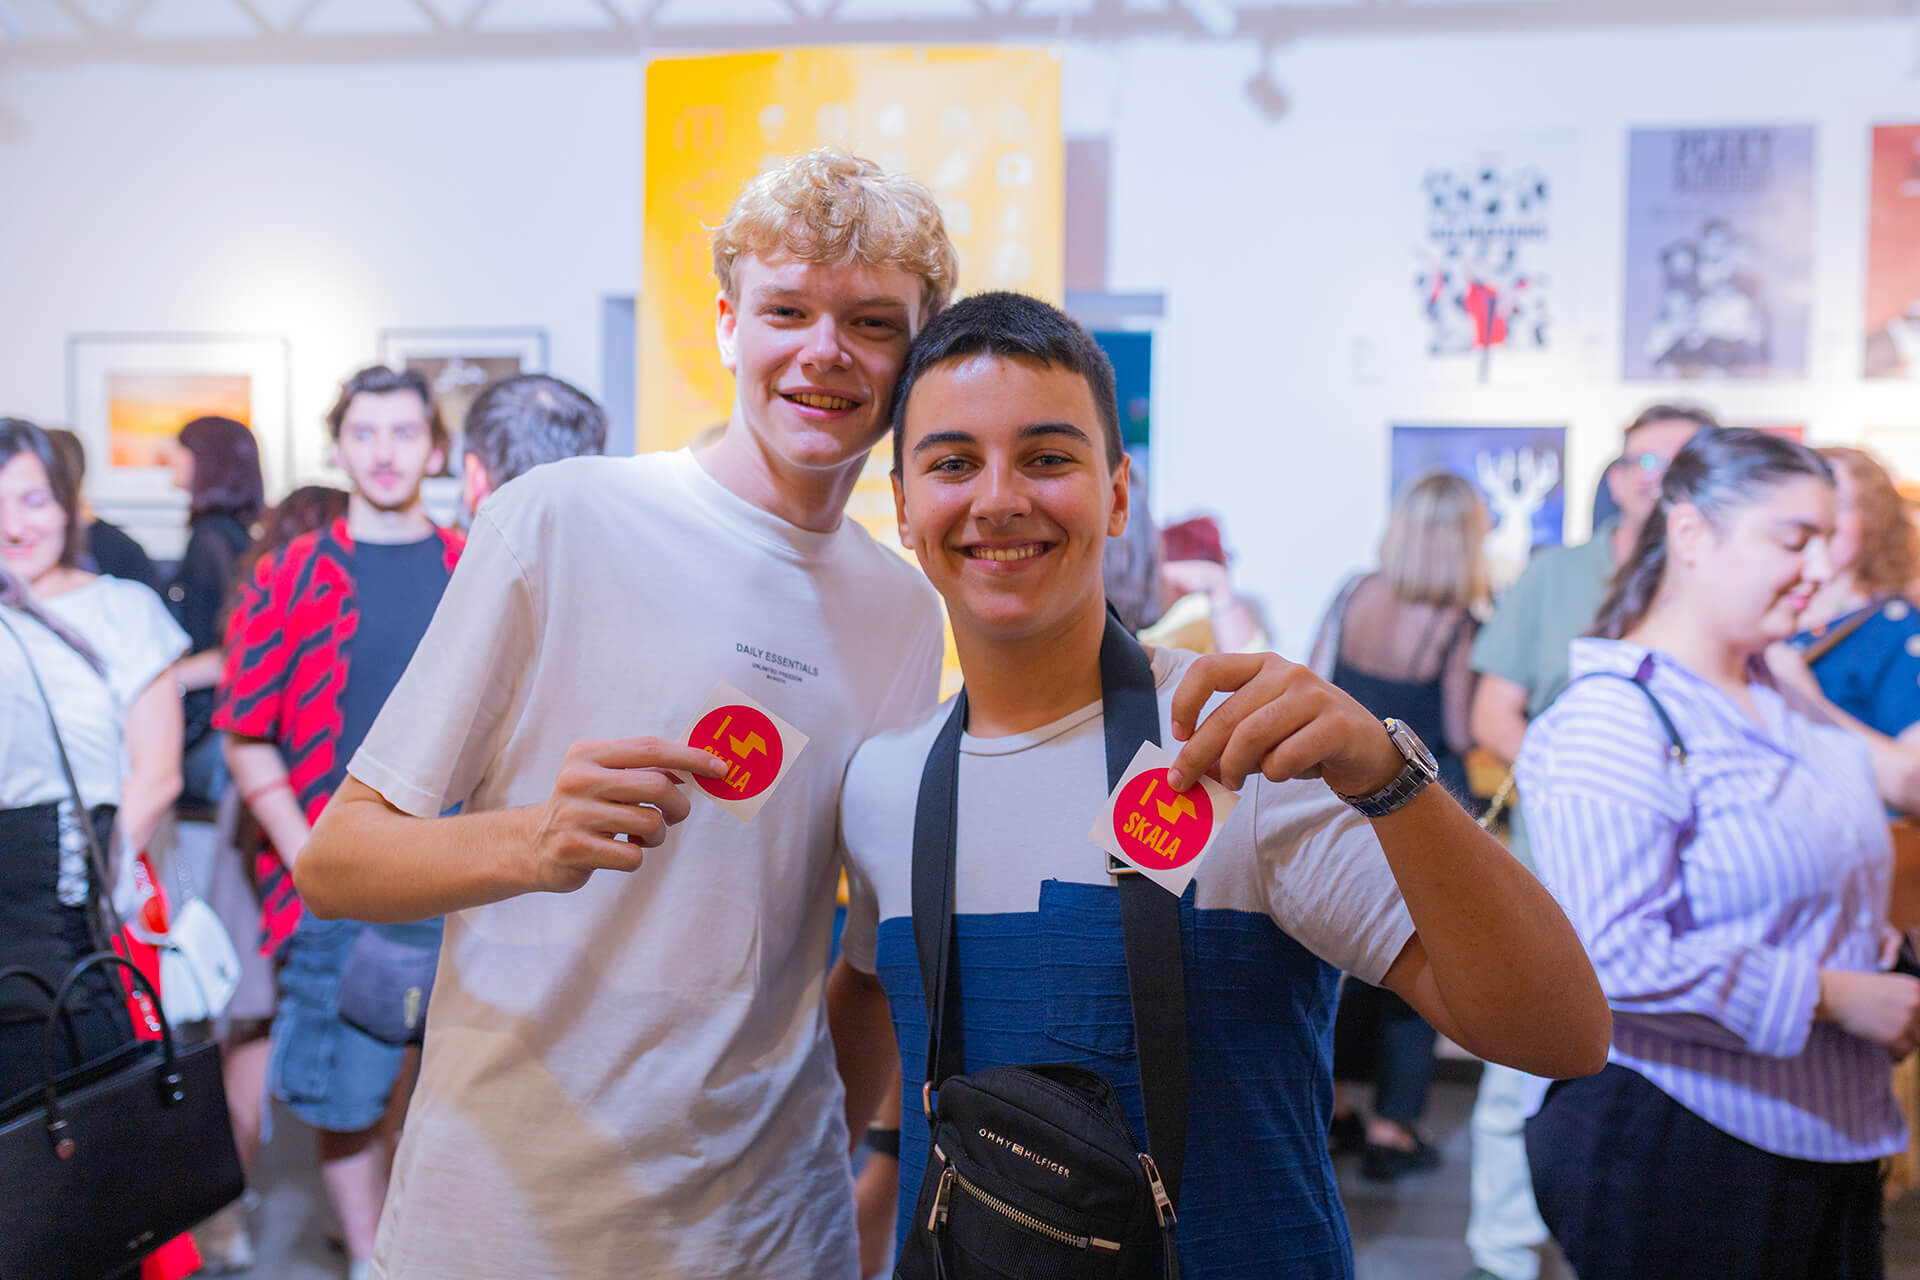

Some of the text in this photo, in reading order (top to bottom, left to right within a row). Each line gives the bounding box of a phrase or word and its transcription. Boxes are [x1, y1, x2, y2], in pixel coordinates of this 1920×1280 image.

[736, 642, 818, 677] DAILY ESSENTIALS
[713, 715, 733, 741] I
[1138, 778, 1159, 807] I
[1122, 811, 1181, 861] SKALA
[1023, 1150, 1070, 1179] HILFIGER
